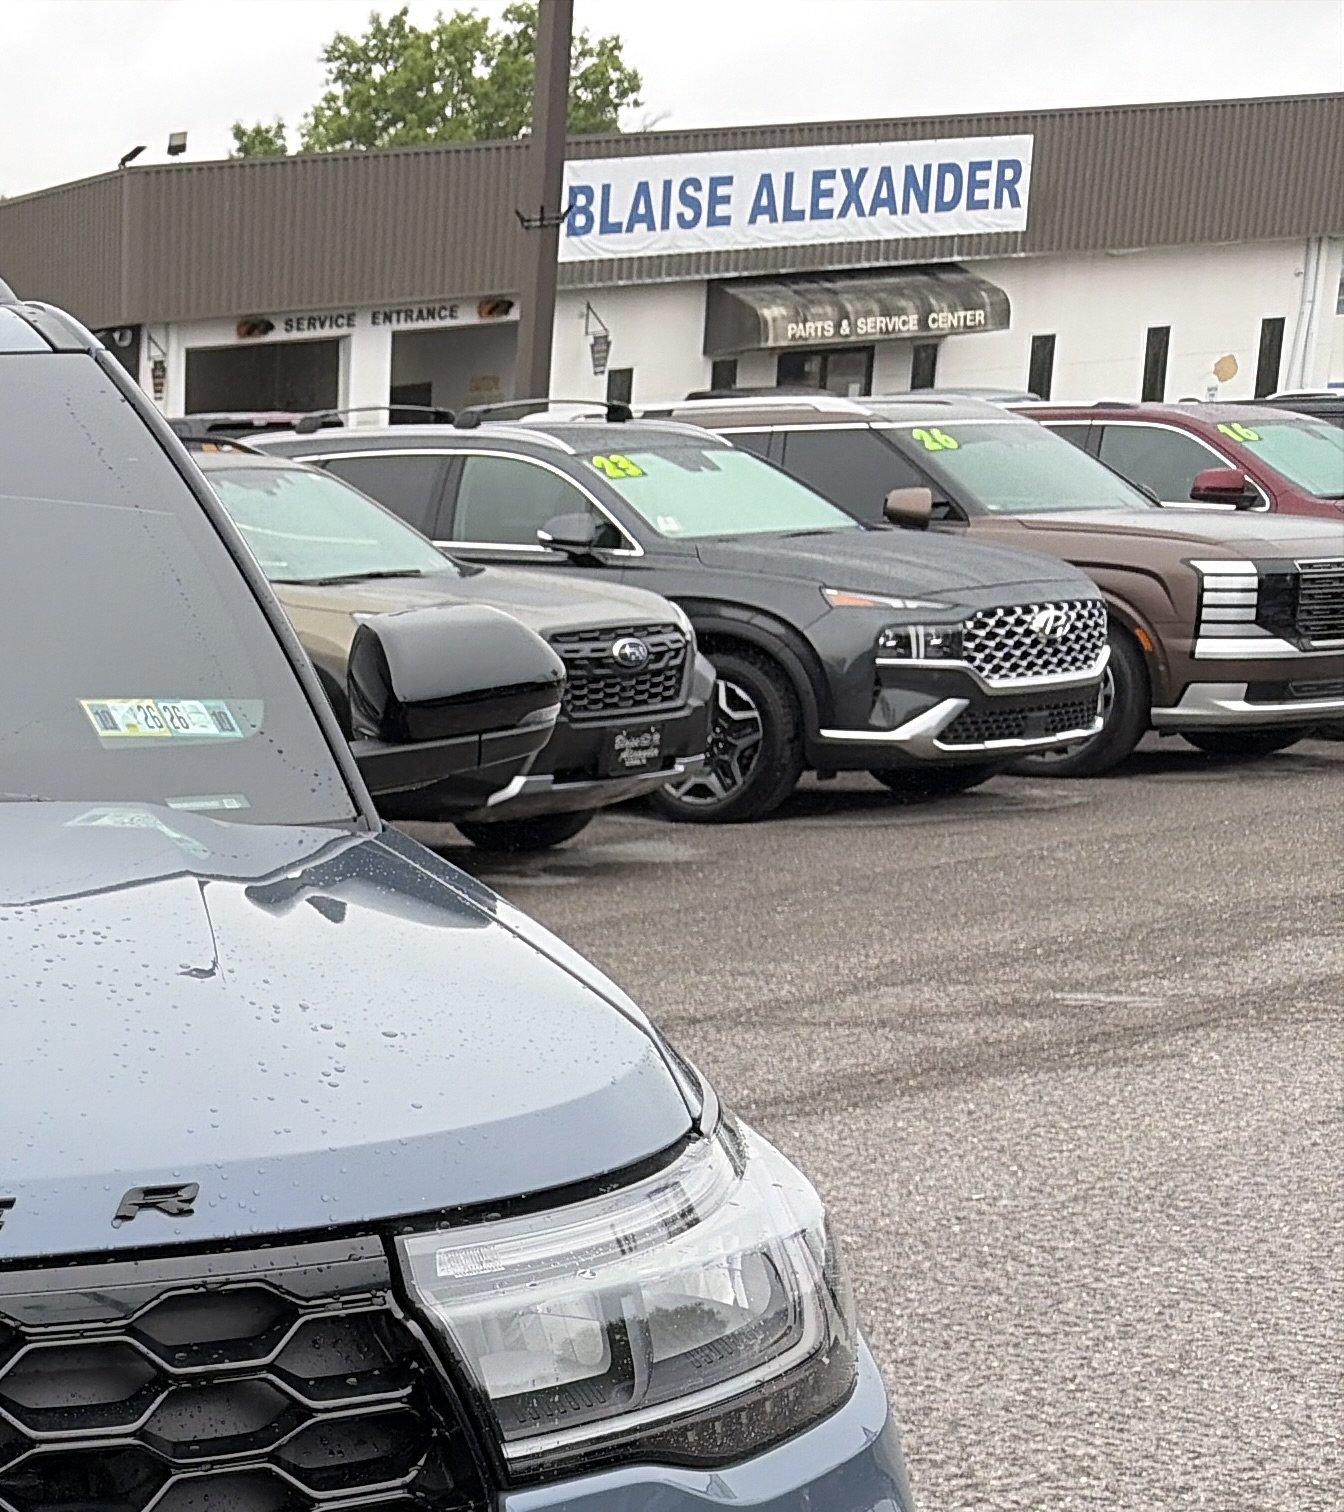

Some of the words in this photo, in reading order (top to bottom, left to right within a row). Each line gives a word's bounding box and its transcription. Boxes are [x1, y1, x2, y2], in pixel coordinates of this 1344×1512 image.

[565, 175, 735, 238] BLAISE
[747, 158, 1023, 226] ALEXANDER
[283, 312, 357, 333] SERVICE
[370, 304, 460, 326] ENTRANCE
[787, 320, 834, 339] PARTS
[839, 318, 851, 336] &
[856, 314, 919, 334] SERVICE
[927, 309, 985, 329] CENTER
[912, 427, 959, 451] 26
[1216, 422, 1259, 442] 16
[592, 454, 643, 479] 23
[137, 704, 164, 730] 26
[162, 705, 190, 730] 26
